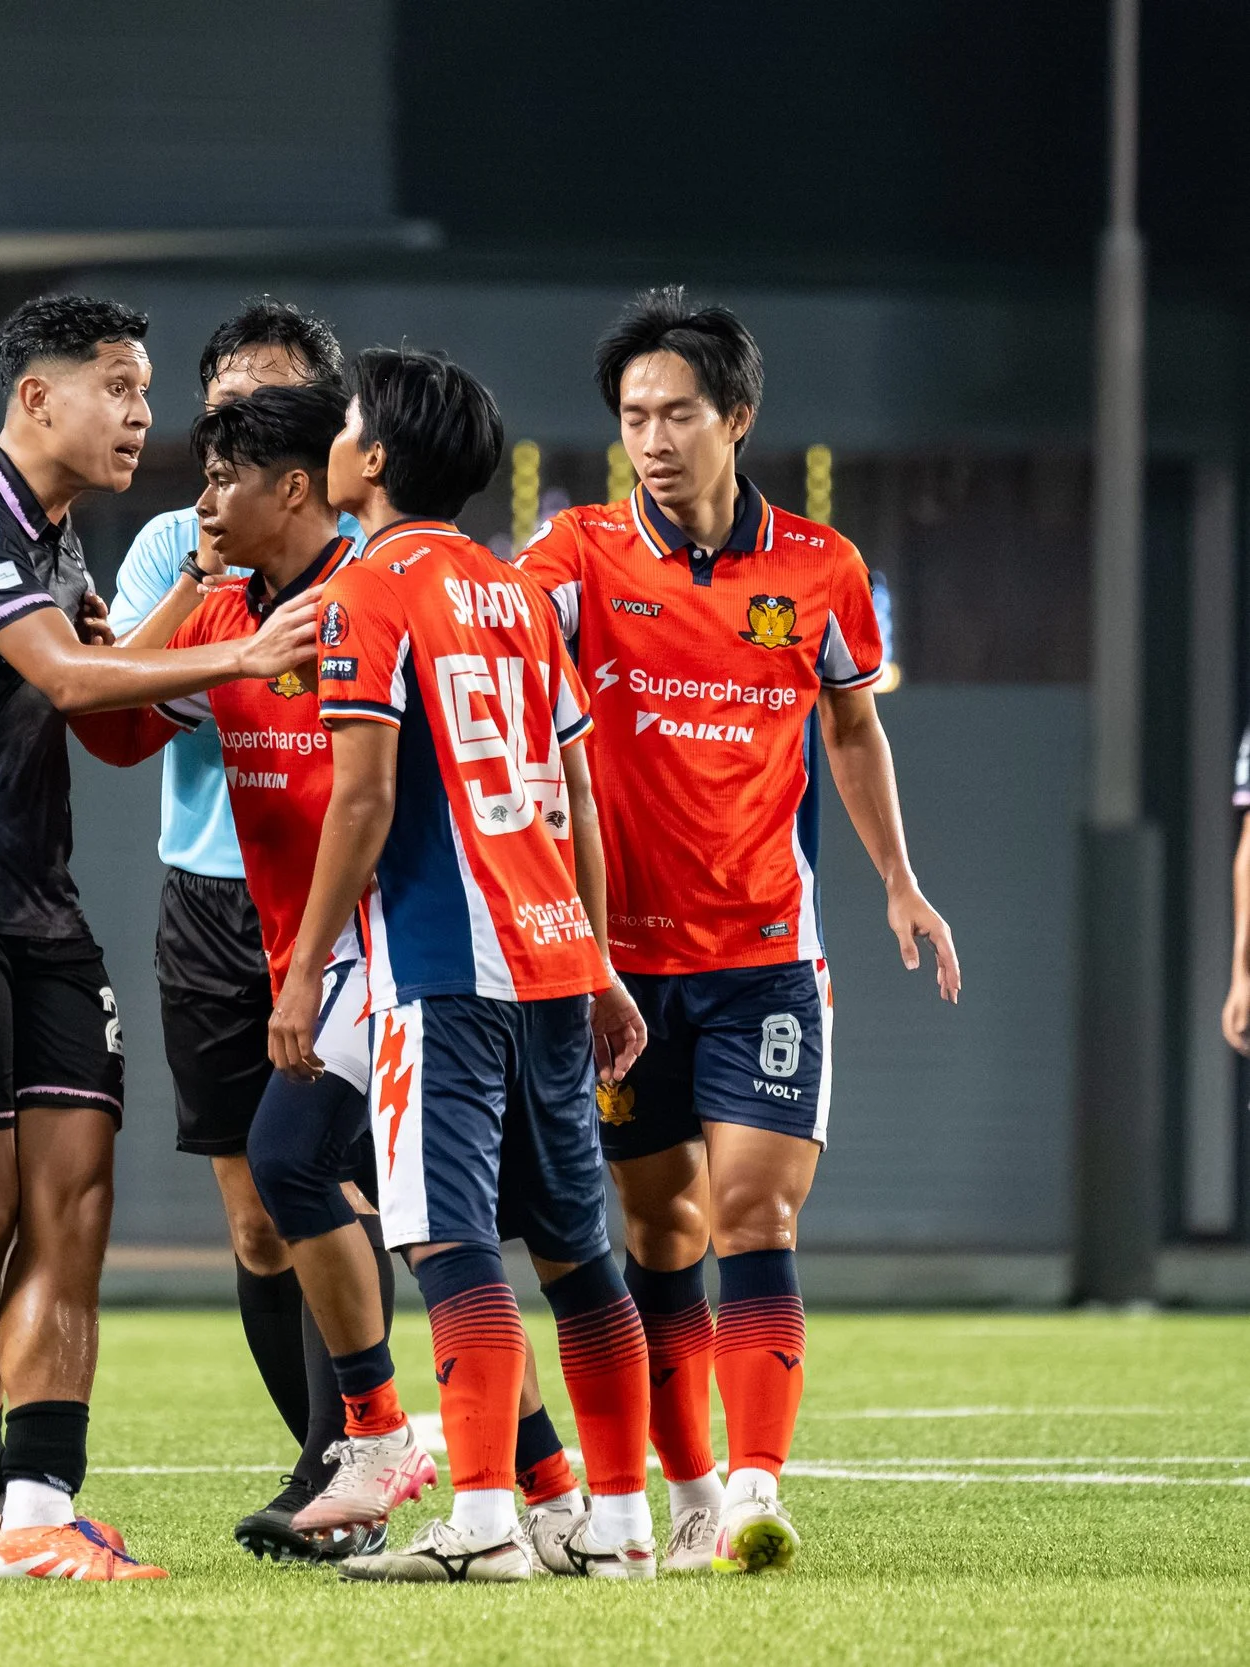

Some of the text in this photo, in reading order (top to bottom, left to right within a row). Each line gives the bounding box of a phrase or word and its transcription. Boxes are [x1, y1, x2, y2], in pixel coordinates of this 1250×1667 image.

[783, 531, 825, 548] AP 21
[321, 660, 352, 672] ORTS
[629, 669, 797, 711] Supercharge
[658, 719, 755, 743] DAIKIN
[435, 653, 572, 841] 54
[238, 771, 289, 790] DAIKIN
[542, 918, 594, 945] FITNE
[760, 1013, 802, 1078] 8
